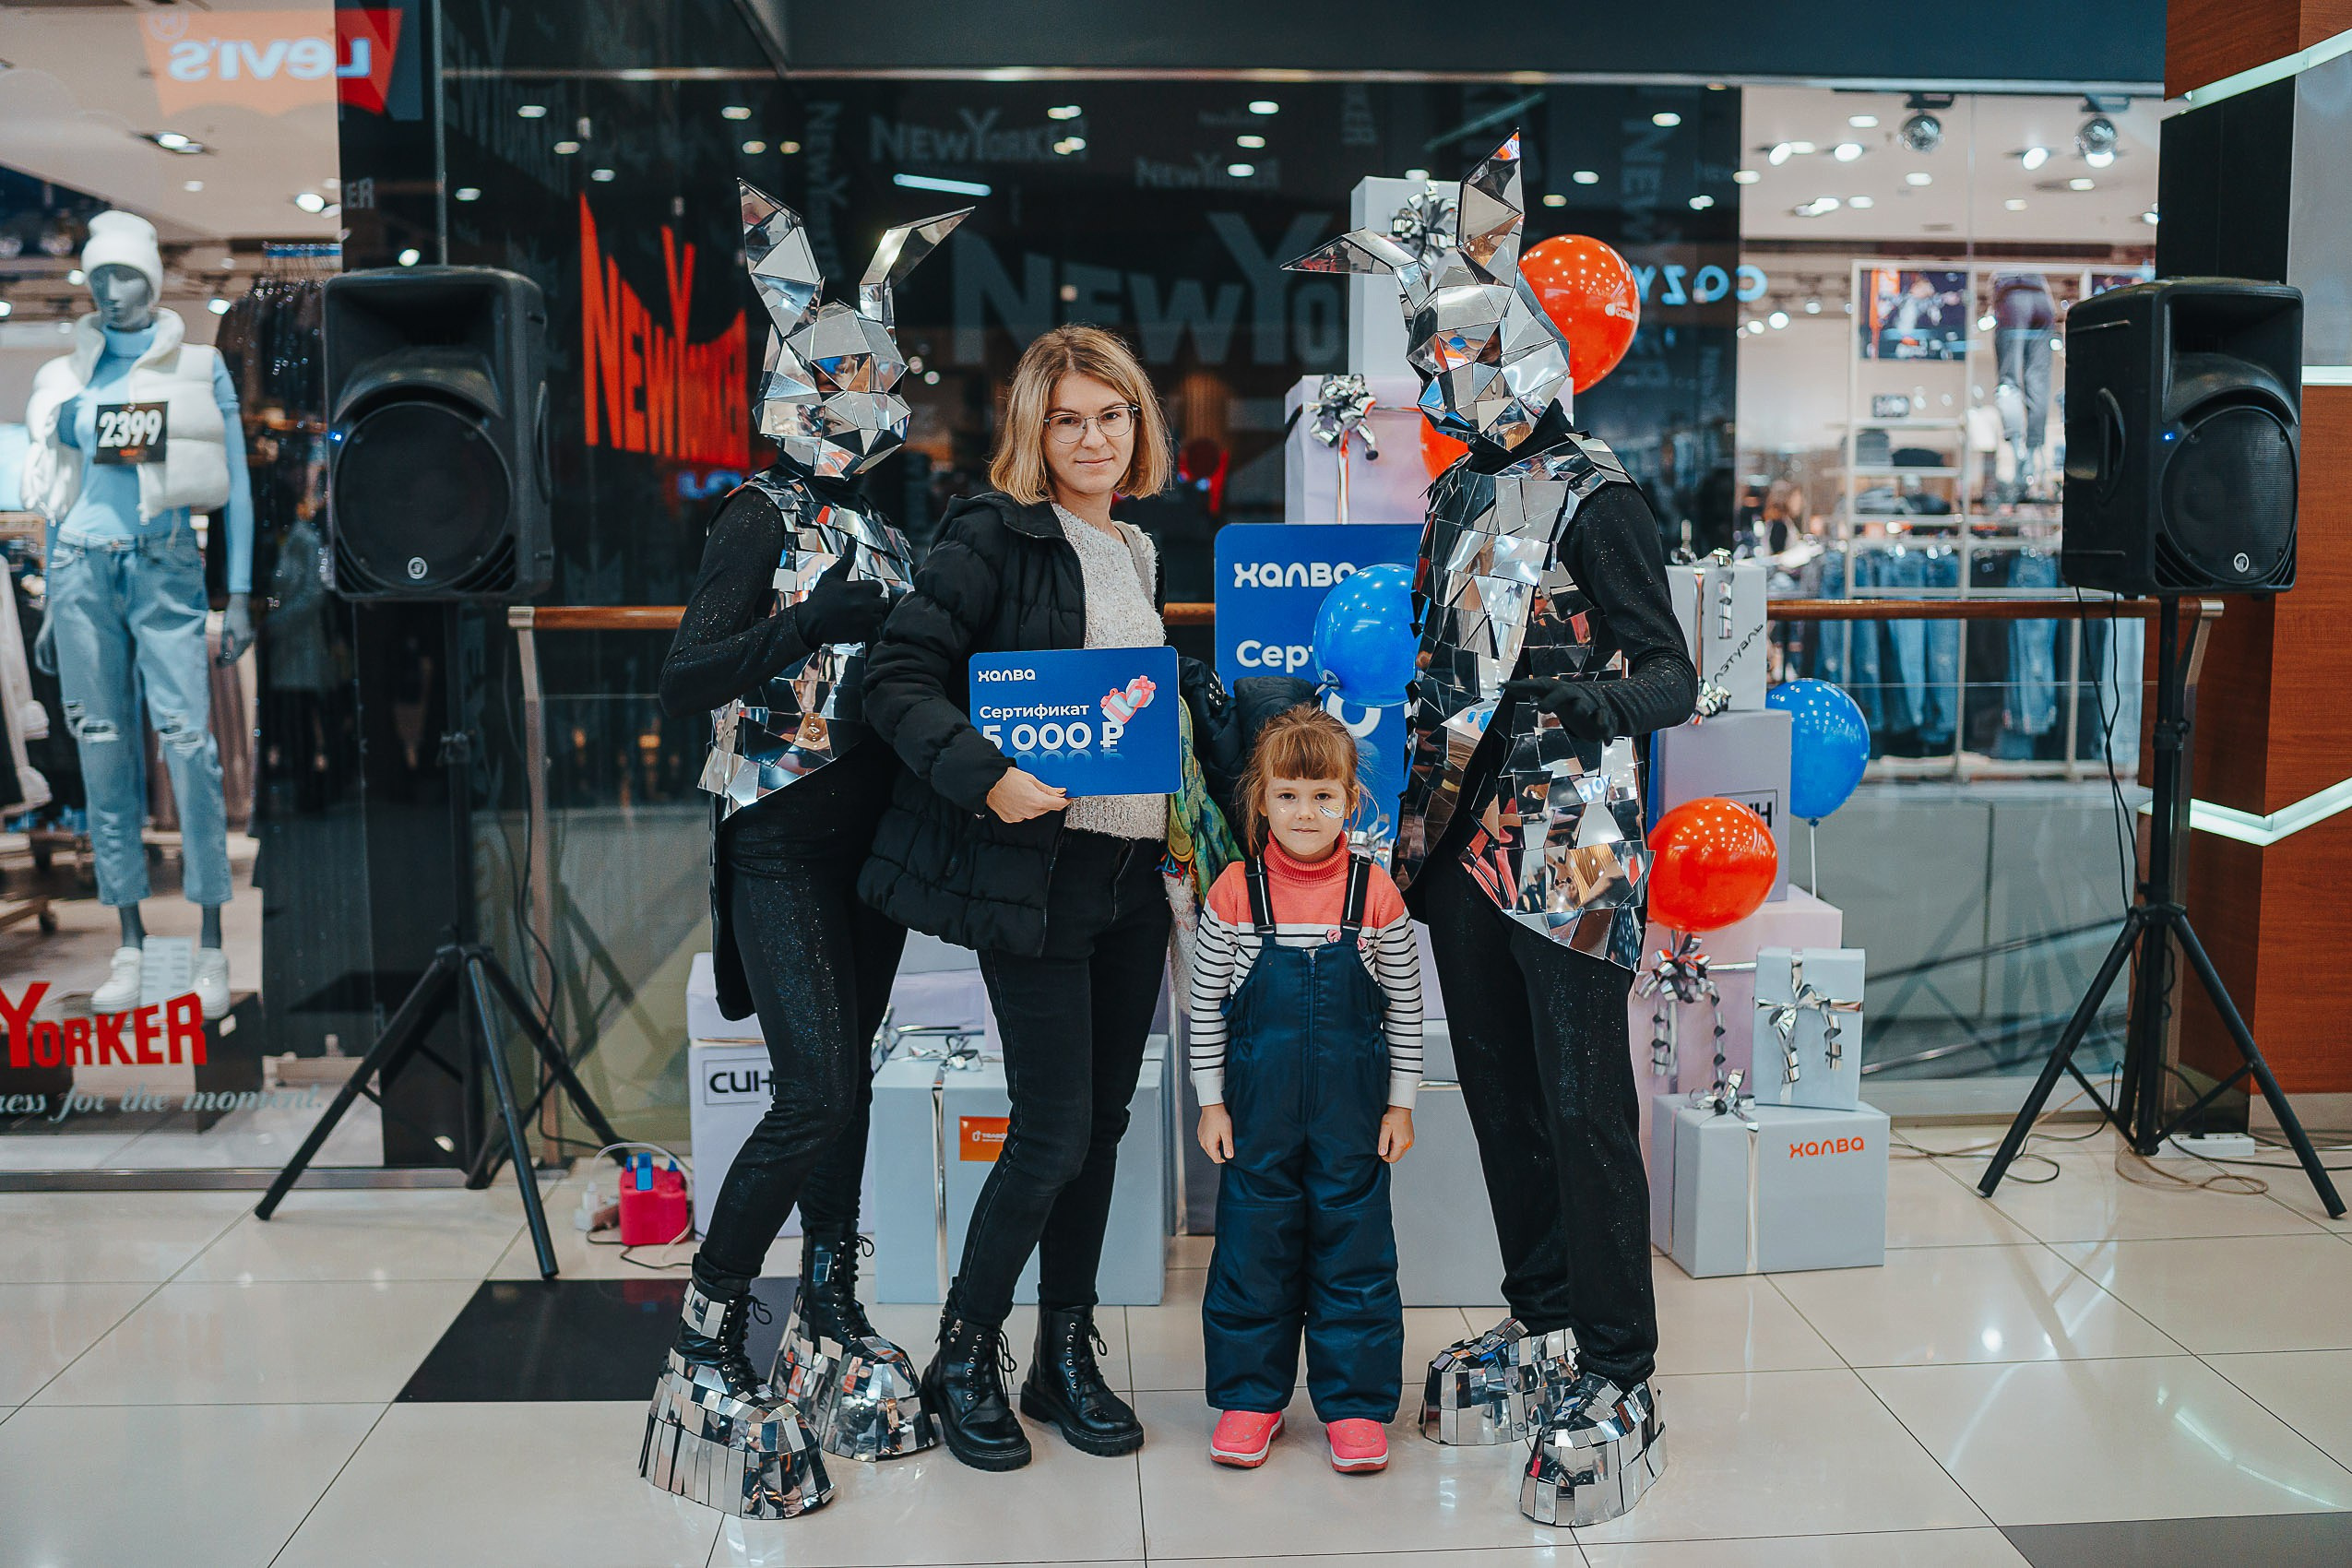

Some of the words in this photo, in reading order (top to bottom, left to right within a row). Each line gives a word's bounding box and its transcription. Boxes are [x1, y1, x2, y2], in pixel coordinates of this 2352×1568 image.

[98, 409, 162, 448] 2399
[979, 703, 1090, 720] Сертификат
[1011, 721, 1092, 751] 000
[48, 1083, 105, 1123] for
[119, 1084, 170, 1111] the
